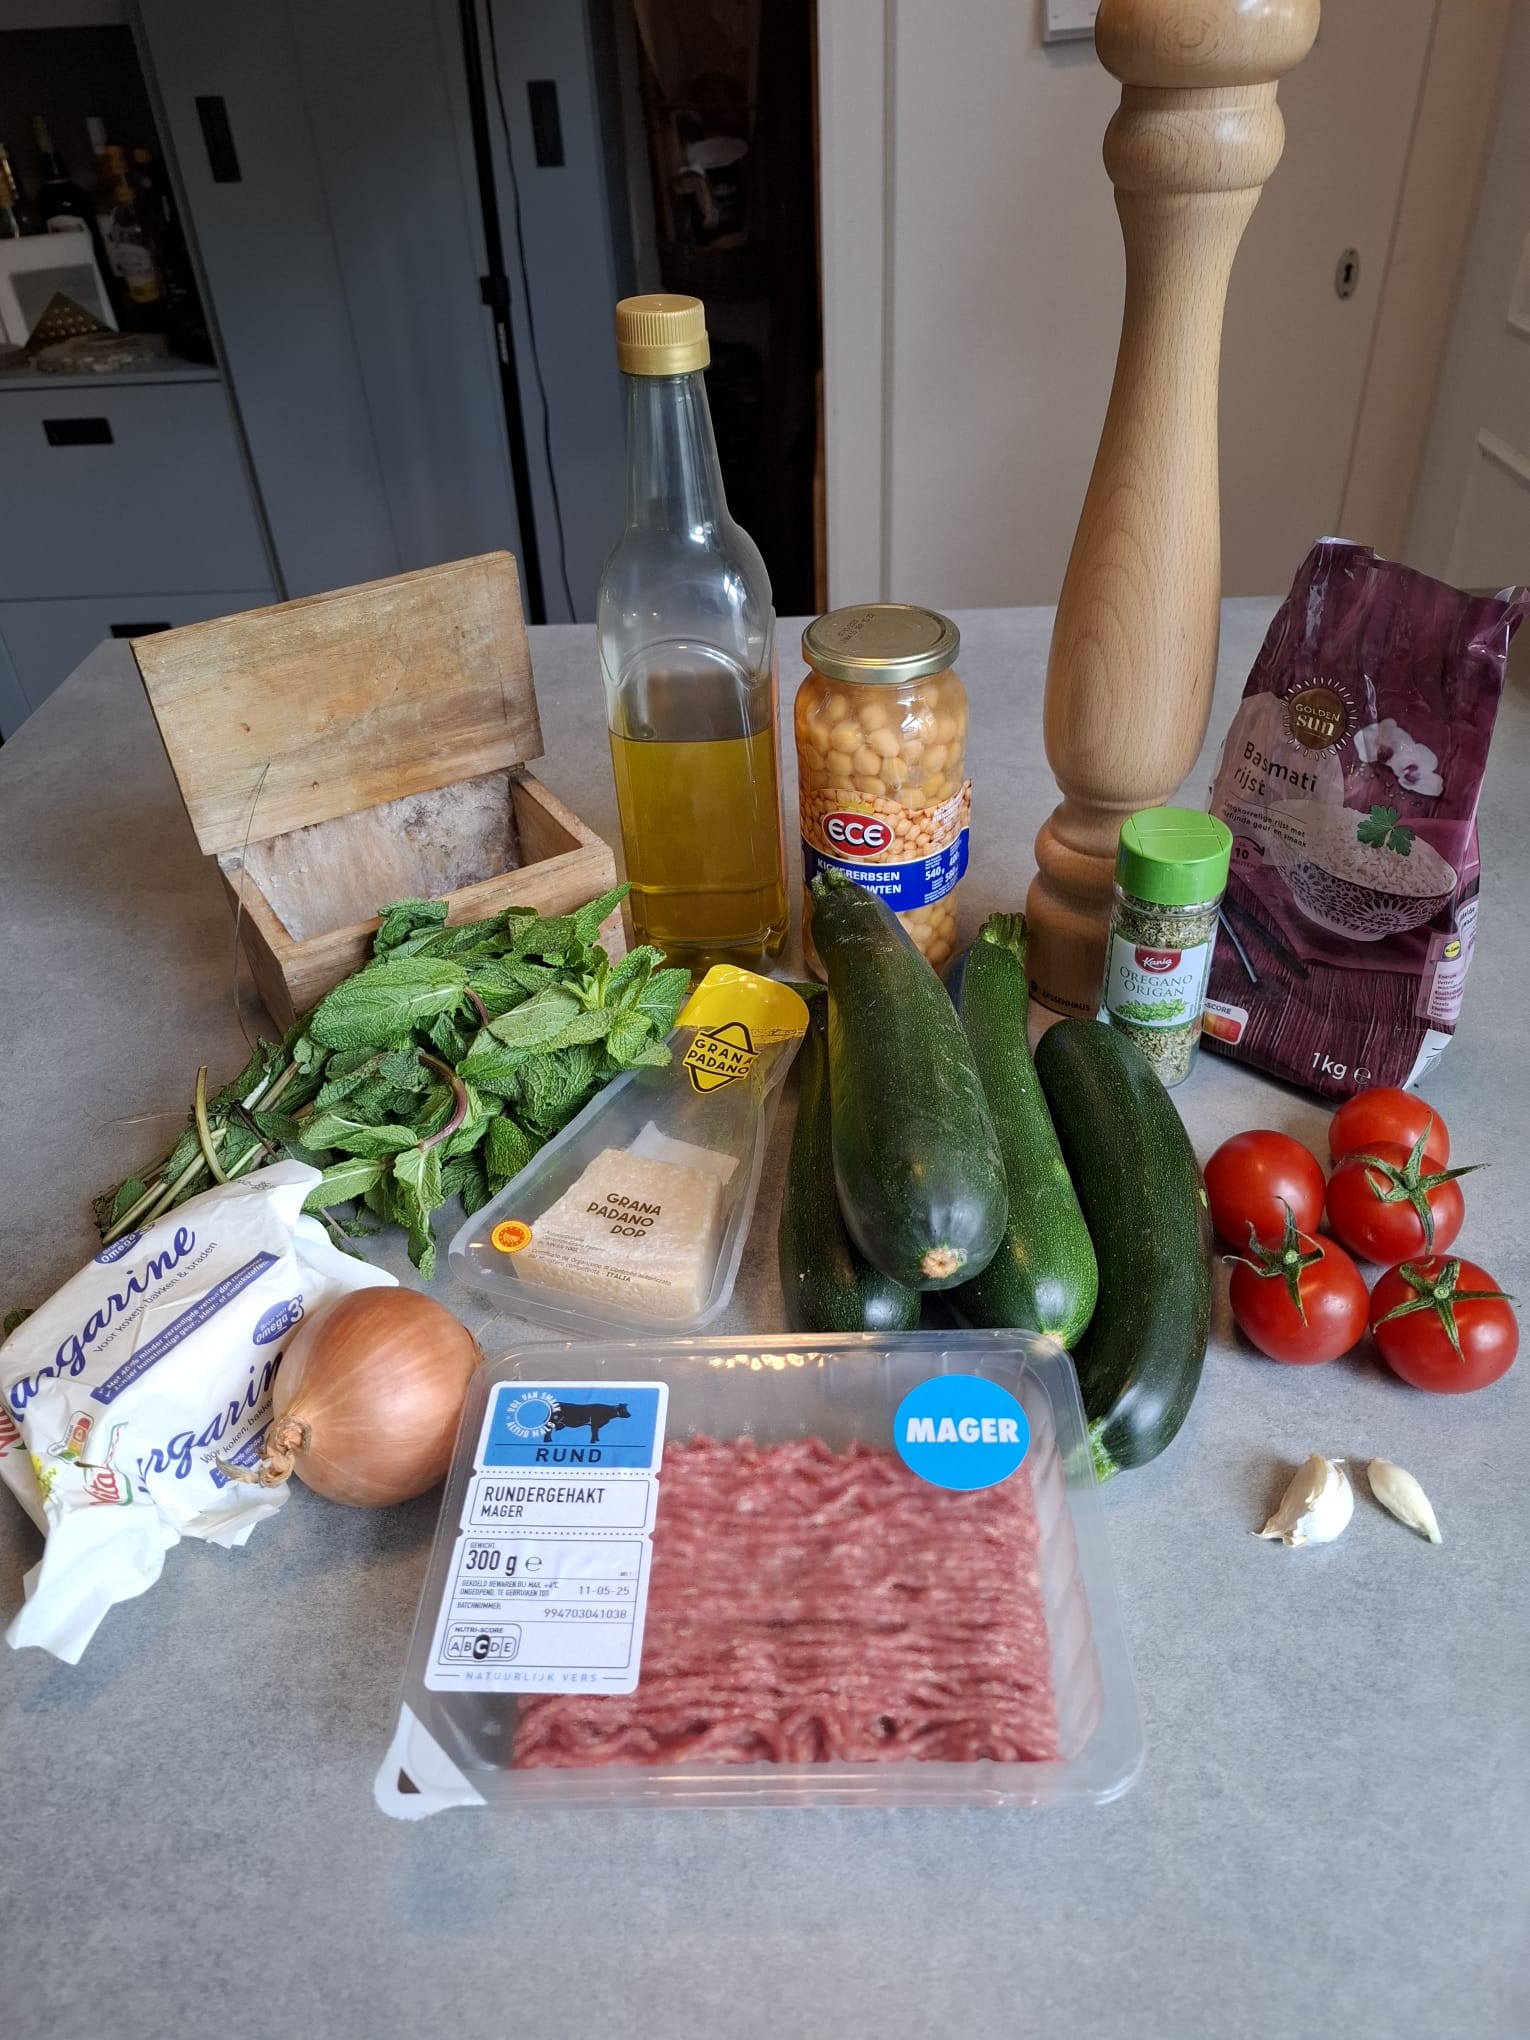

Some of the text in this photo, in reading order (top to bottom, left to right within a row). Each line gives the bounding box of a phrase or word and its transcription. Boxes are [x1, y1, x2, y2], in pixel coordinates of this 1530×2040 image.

[1295, 703, 1341, 723] GOLDEN
[1296, 715, 1335, 737] sun
[1244, 741, 1317, 793] Basmati
[1234, 766, 1265, 796] rijst
[828, 818, 885, 847] ECE
[1235, 847, 1249, 859] 10
[925, 866, 941, 881] 540
[1120, 966, 1193, 987] OREGANO
[1124, 980, 1185, 997] ORIGAN
[1204, 1003, 1232, 1015] -SCORE
[695, 1038, 755, 1065] GRANA
[687, 1050, 750, 1076] PADANO
[587, 1202, 655, 1227] PADANO
[606, 1193, 662, 1216] GRANA
[610, 1225, 646, 1238] DOP
[606, 1272, 631, 1282] ITALIA
[93, 1333, 118, 1353] Voor
[143, 1279, 180, 1304] bakken
[177, 1271, 188, 1280] &
[184, 1242, 218, 1271] braden
[10, 1226, 196, 1412] argarine
[139, 1339, 164, 1359] minder
[163, 1309, 199, 1340] verzadigde
[198, 1292, 220, 1310] vetten
[219, 1281, 233, 1294] dan
[287, 1298, 303, 1323] 3
[137, 1334, 180, 1370] kunstmatige
[219, 1295, 226, 1303] of
[506, 1392, 561, 1413] VOL VAN SMAAK
[138, 1352, 283, 1494] rgarin
[506, 1421, 555, 1438] ALTIJD MALS
[906, 1417, 1020, 1443] MAGER
[222, 1424, 249, 1454] koken,
[535, 1448, 602, 1464] RUND
[484, 1486, 606, 1504] RUNDERGEHAKT
[480, 1504, 524, 1518] MAGER
[466, 1549, 501, 1570] 300
[505, 1556, 517, 1576] g
[489, 1580, 516, 1588] BEWAREN
[505, 1589, 537, 1597] GEBRUIKEN
[578, 1584, 630, 1597] 11-05-25
[544, 1607, 627, 1619] 994703041038
[454, 1626, 503, 1634] NUTRI-SCORE
[450, 1639, 512, 1654] A B C D E
[465, 1671, 598, 1682] NATUURLIJK VERS
